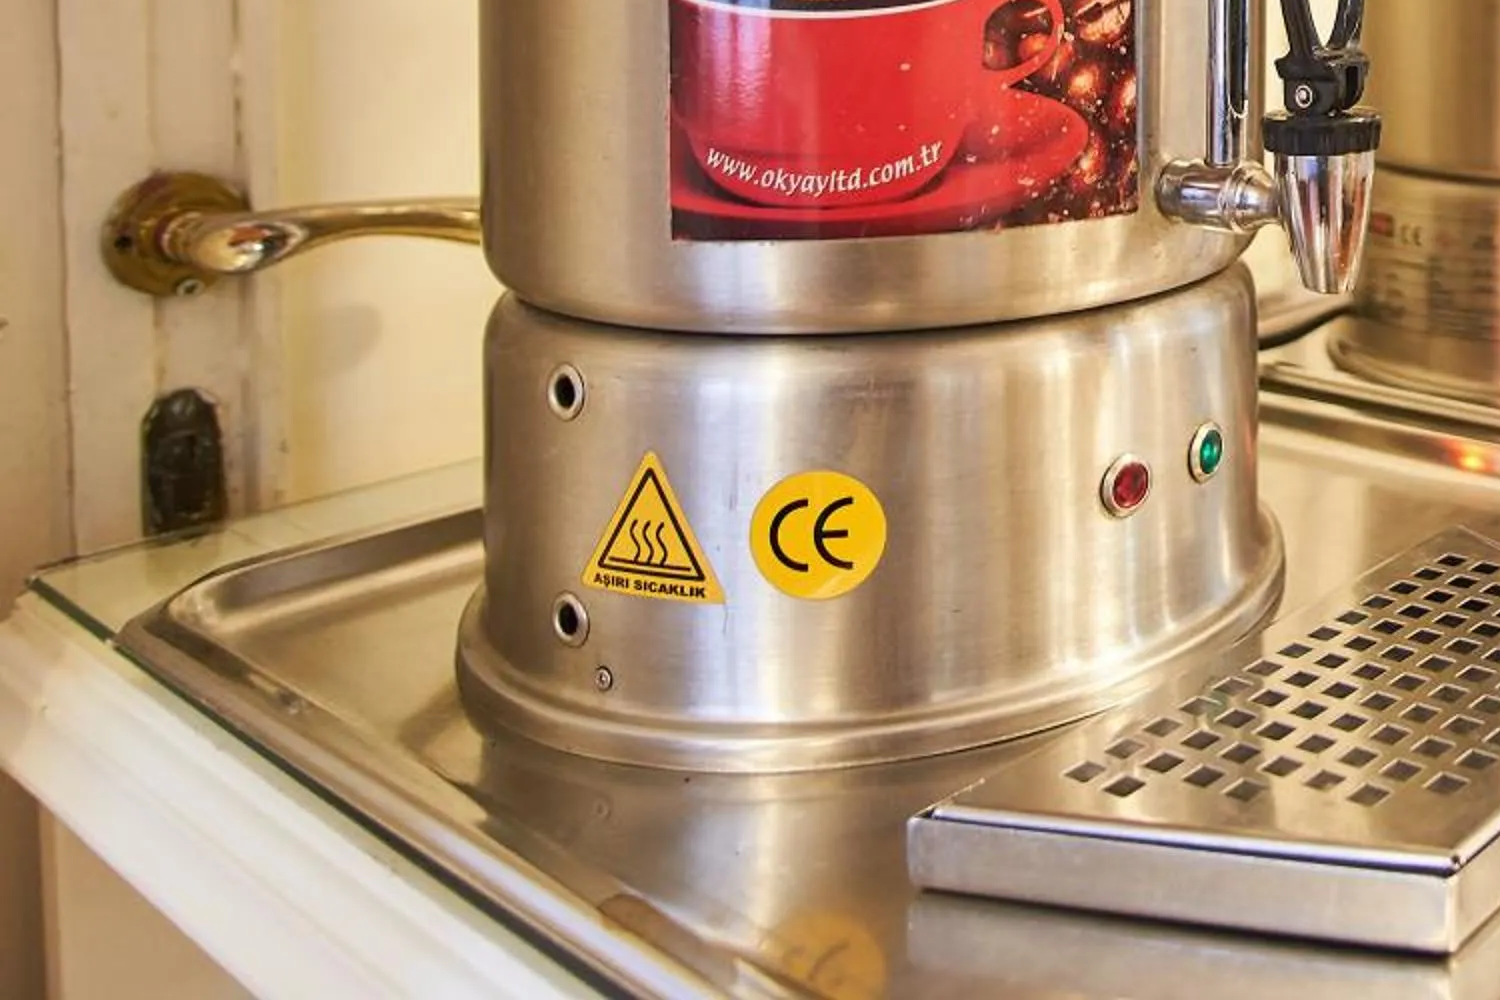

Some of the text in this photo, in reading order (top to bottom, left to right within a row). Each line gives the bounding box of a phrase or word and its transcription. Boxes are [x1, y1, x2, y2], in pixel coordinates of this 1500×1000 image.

[706, 140, 943, 198] www.okyayltd.com.tr
[768, 496, 854, 573] CE
[593, 572, 706, 600] AŞIRI SICAKLIK
